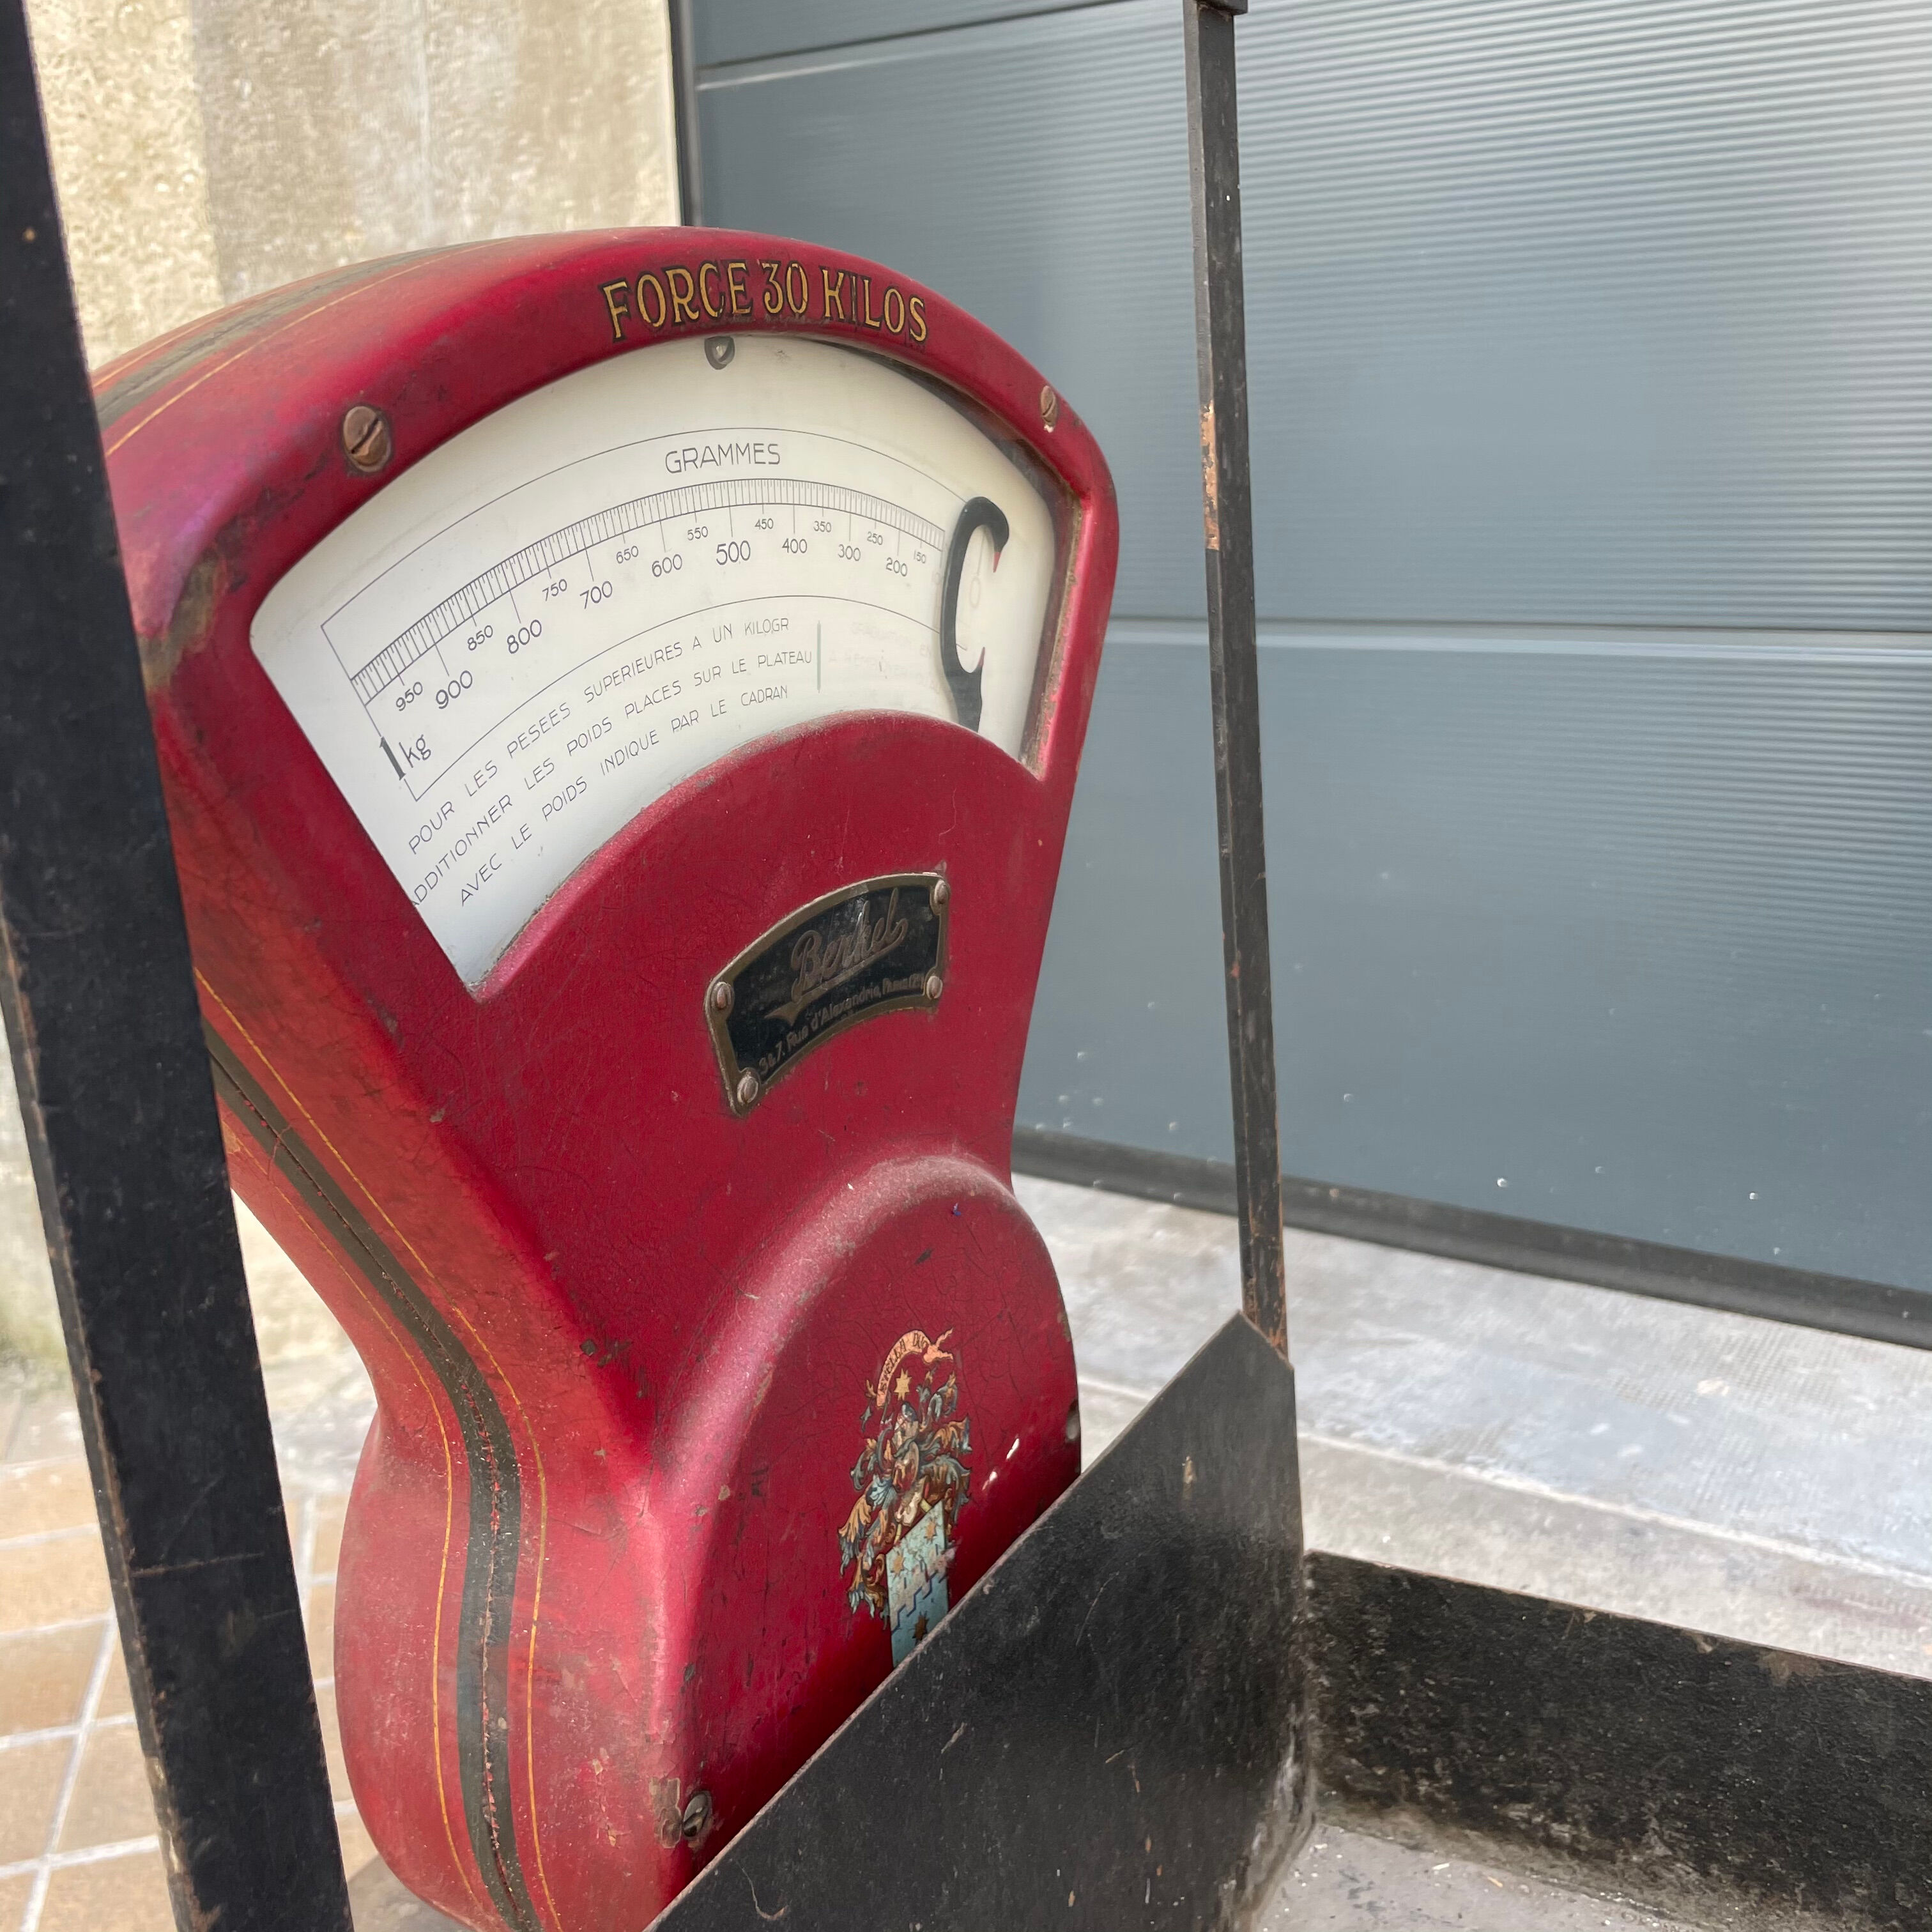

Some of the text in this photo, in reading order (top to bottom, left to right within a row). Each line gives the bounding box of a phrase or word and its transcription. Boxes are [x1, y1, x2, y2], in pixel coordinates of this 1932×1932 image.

[600, 260, 926, 342] FORCE 30 KILOS
[664, 442, 781, 474] GRAMMES
[687, 526, 709, 541] 550
[754, 518, 774, 530] 450
[813, 520, 832, 533] 350
[781, 538, 808, 554] 400
[866, 531, 884, 546] 250
[615, 545, 640, 564] 650
[716, 540, 751, 565] 500
[837, 544, 861, 562] 300
[913, 549, 927, 564] 150
[651, 553, 683, 578] 600
[885, 556, 908, 578] 200
[542, 578, 568, 602] 750
[579, 580, 613, 610] 700
[466, 624, 494, 651] 850
[507, 618, 542, 654] 800
[395, 681, 424, 712] 950
[435, 670, 473, 709] 900
[523, 757, 555, 791] LES
[566, 716, 613, 757] POIDS
[624, 680, 682, 719] PLACES
[693, 665, 722, 687] SUR
[731, 658, 747, 675] LE
[757, 650, 813, 668] PLATEAU
[408, 617, 790, 855] POUR LES PESEES SUPERIEURES A UN KILOGR
[460, 684, 788, 907] AVEC LE POIDS INDIQUE PAR LE CADRAN
[791, 887, 908, 1002] Berkel
